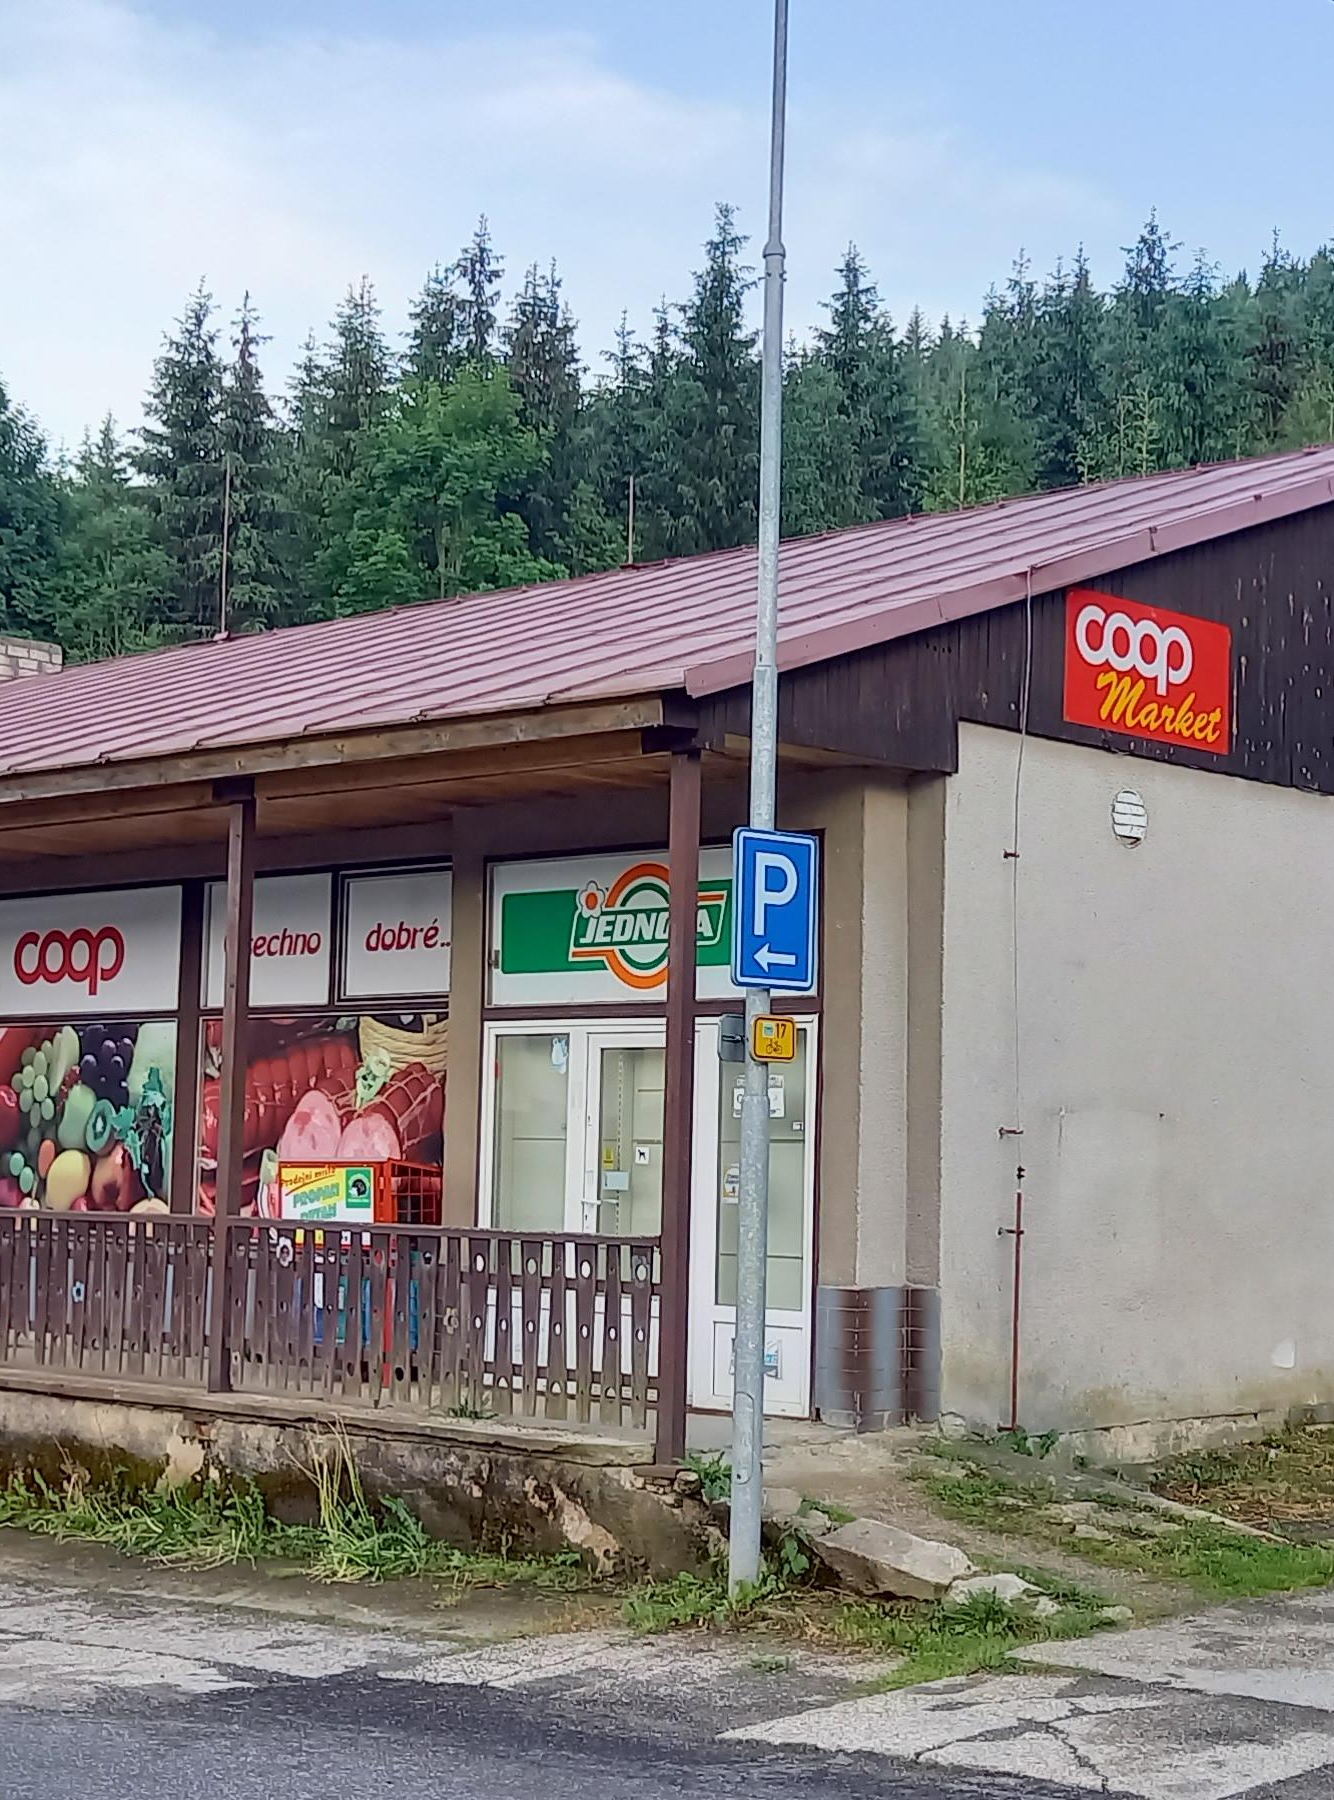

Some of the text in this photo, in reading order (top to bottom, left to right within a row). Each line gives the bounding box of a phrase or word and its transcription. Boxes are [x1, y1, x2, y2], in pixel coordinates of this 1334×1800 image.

[1075, 604, 1193, 697] coop
[1096, 668, 1222, 743] Market
[579, 909, 714, 944] JEDNOA
[753, 852, 798, 936] P
[14, 925, 125, 996] coop
